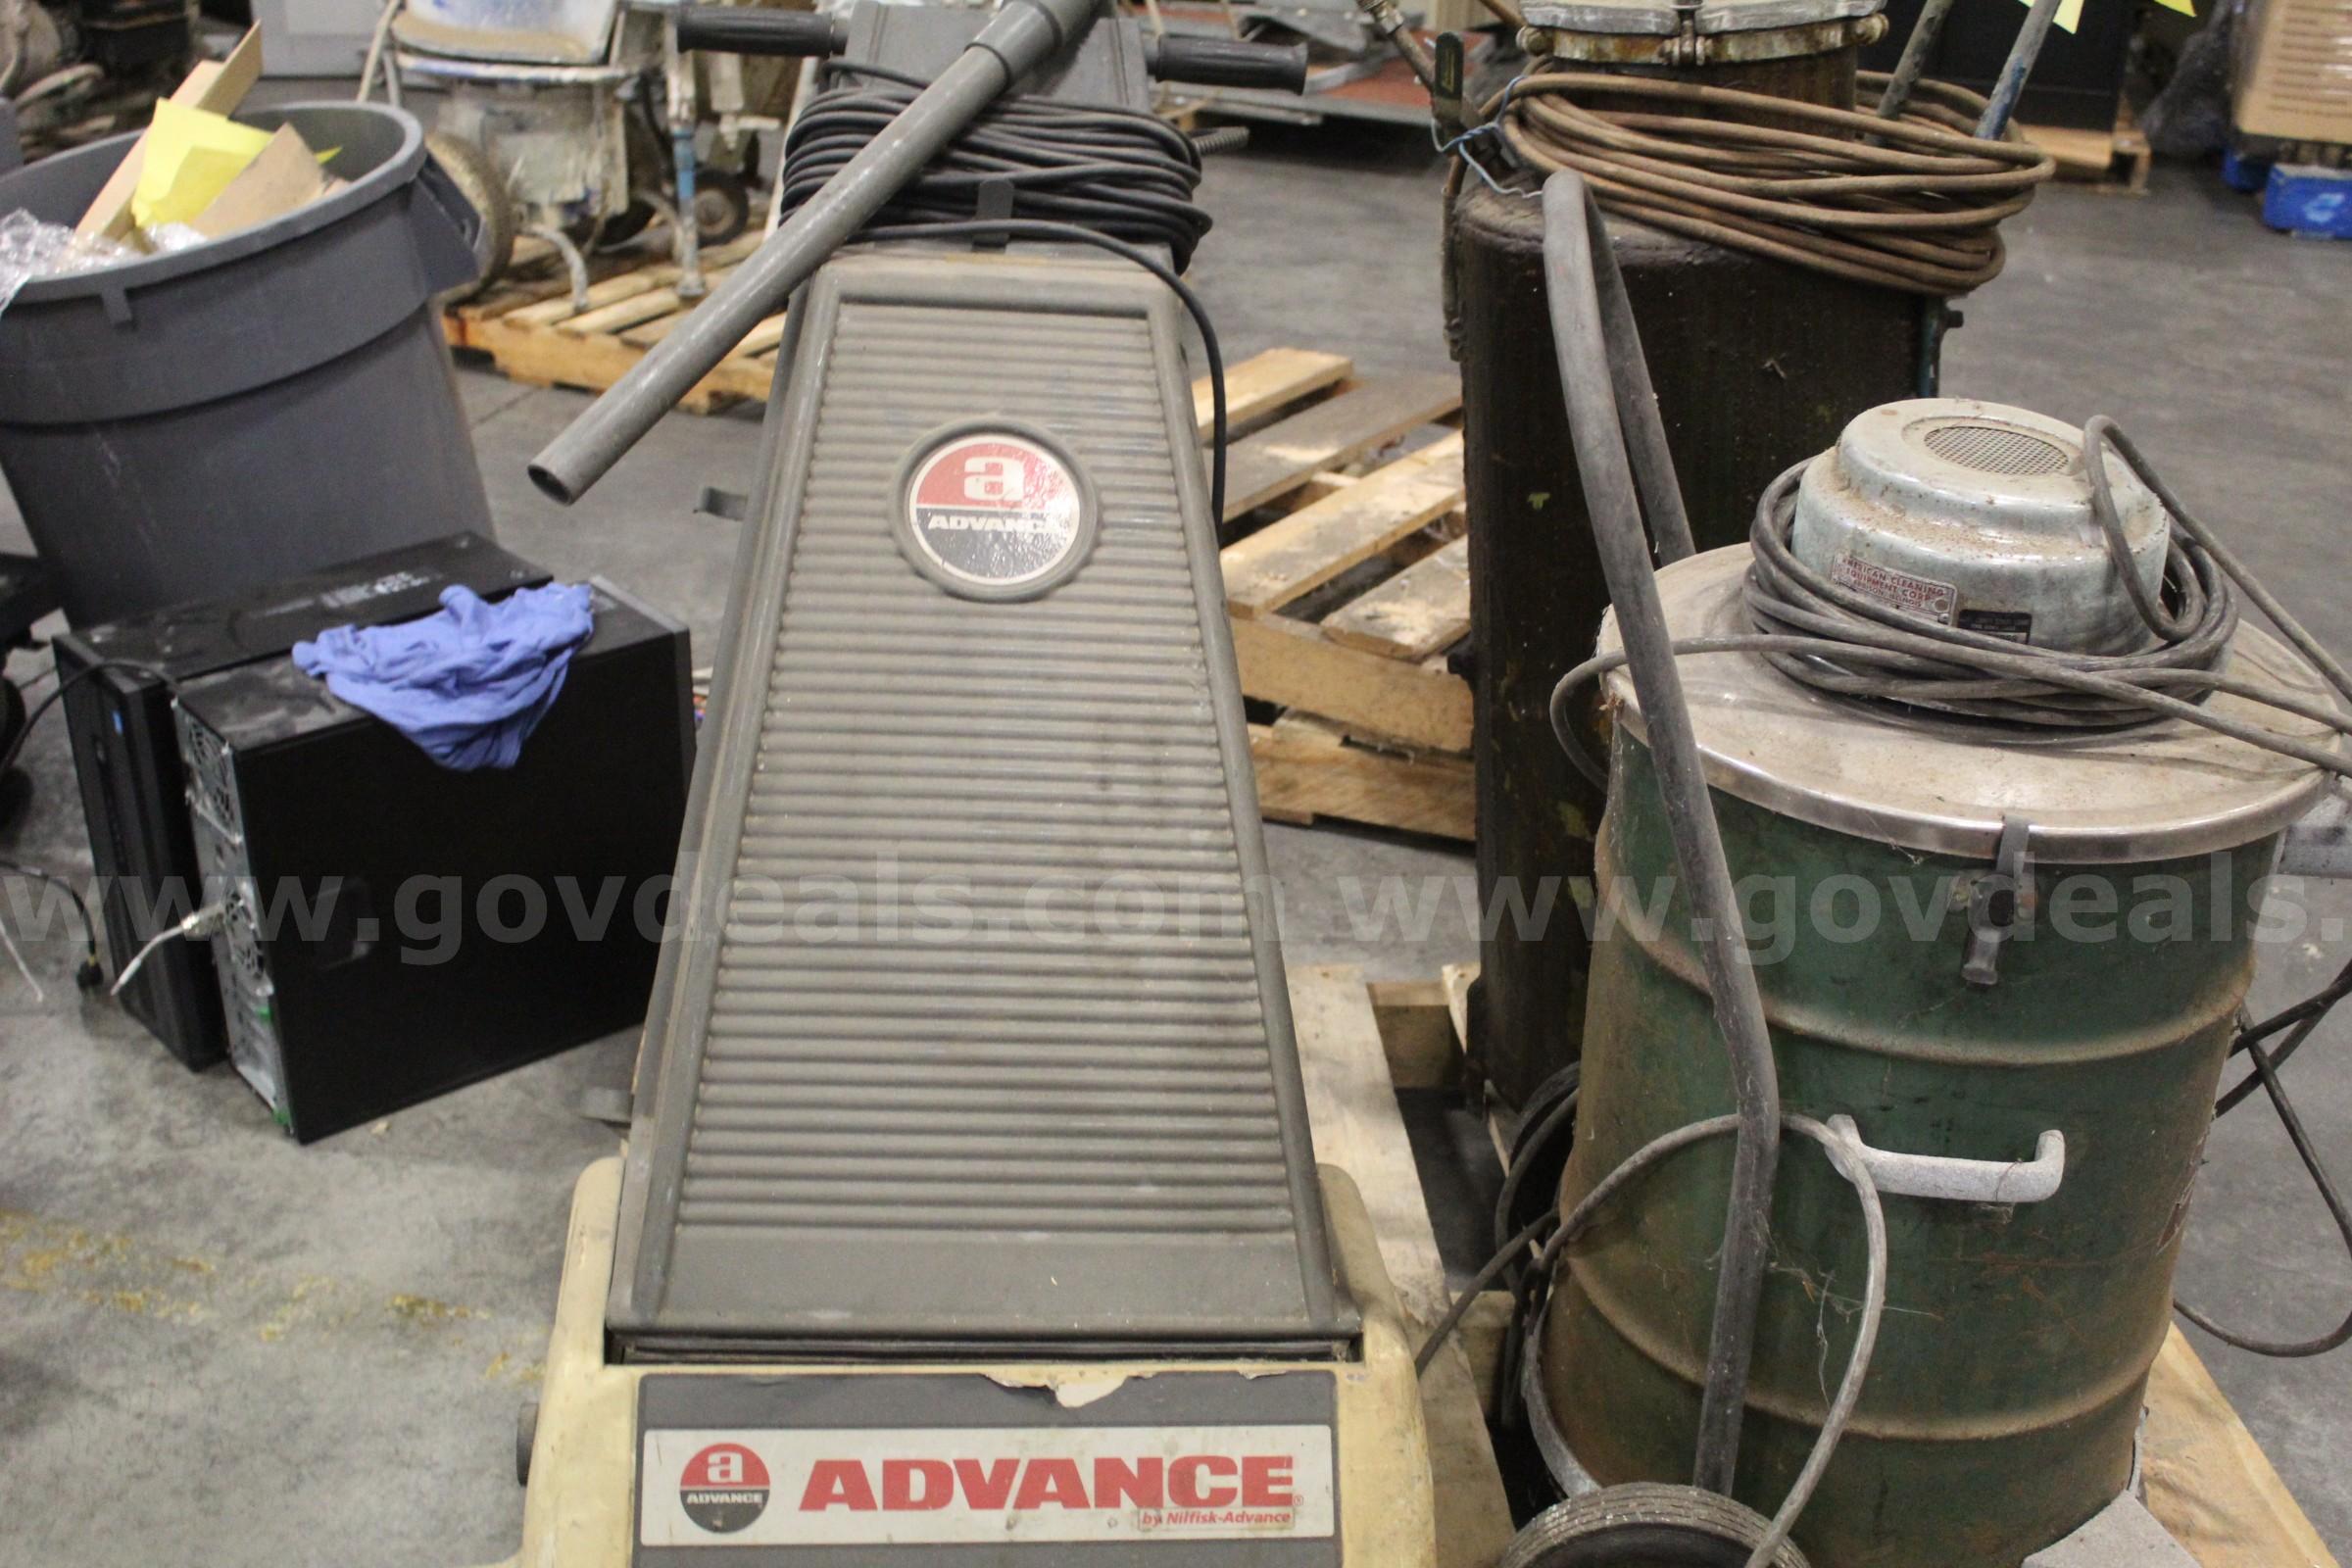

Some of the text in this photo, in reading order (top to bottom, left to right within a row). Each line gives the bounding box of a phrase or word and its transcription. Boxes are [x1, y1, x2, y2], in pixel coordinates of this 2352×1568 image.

[963, 456, 1024, 502] a
[928, 514, 1059, 533] ADVANC
[1890, 576, 1944, 597] CLEANING
[708, 1451, 743, 1483] a
[687, 1492, 762, 1504] ADVANCE
[1142, 1510, 1292, 1528] by Nilfisk-Advance
